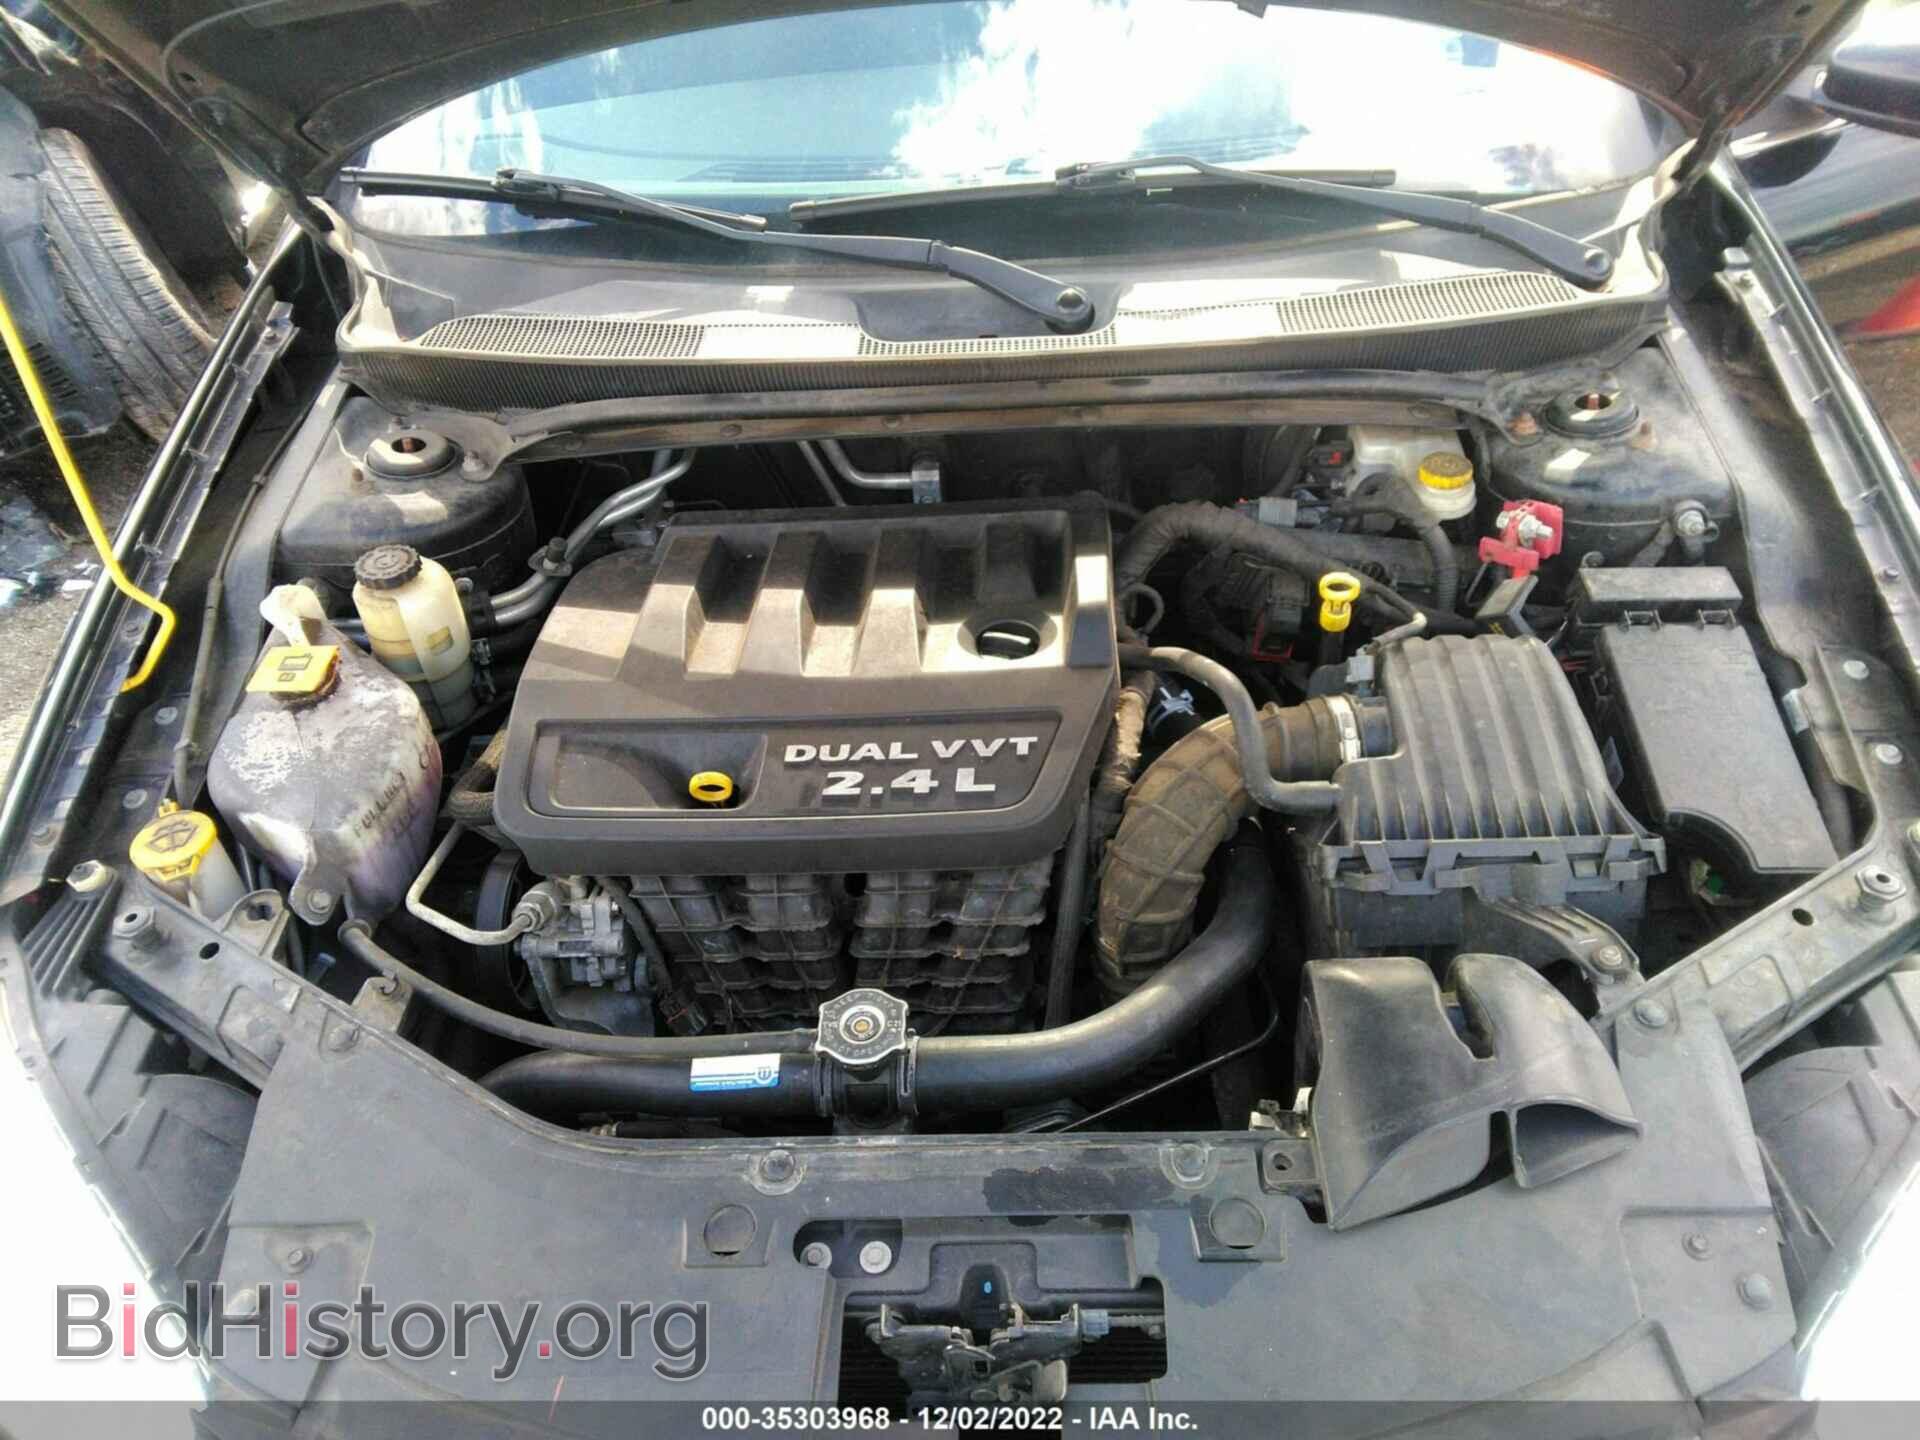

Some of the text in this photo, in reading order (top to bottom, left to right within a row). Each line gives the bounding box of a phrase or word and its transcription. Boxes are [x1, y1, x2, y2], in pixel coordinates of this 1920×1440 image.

[783, 736, 1039, 763] DUAL VVT
[821, 767, 997, 796] 2.4 L
